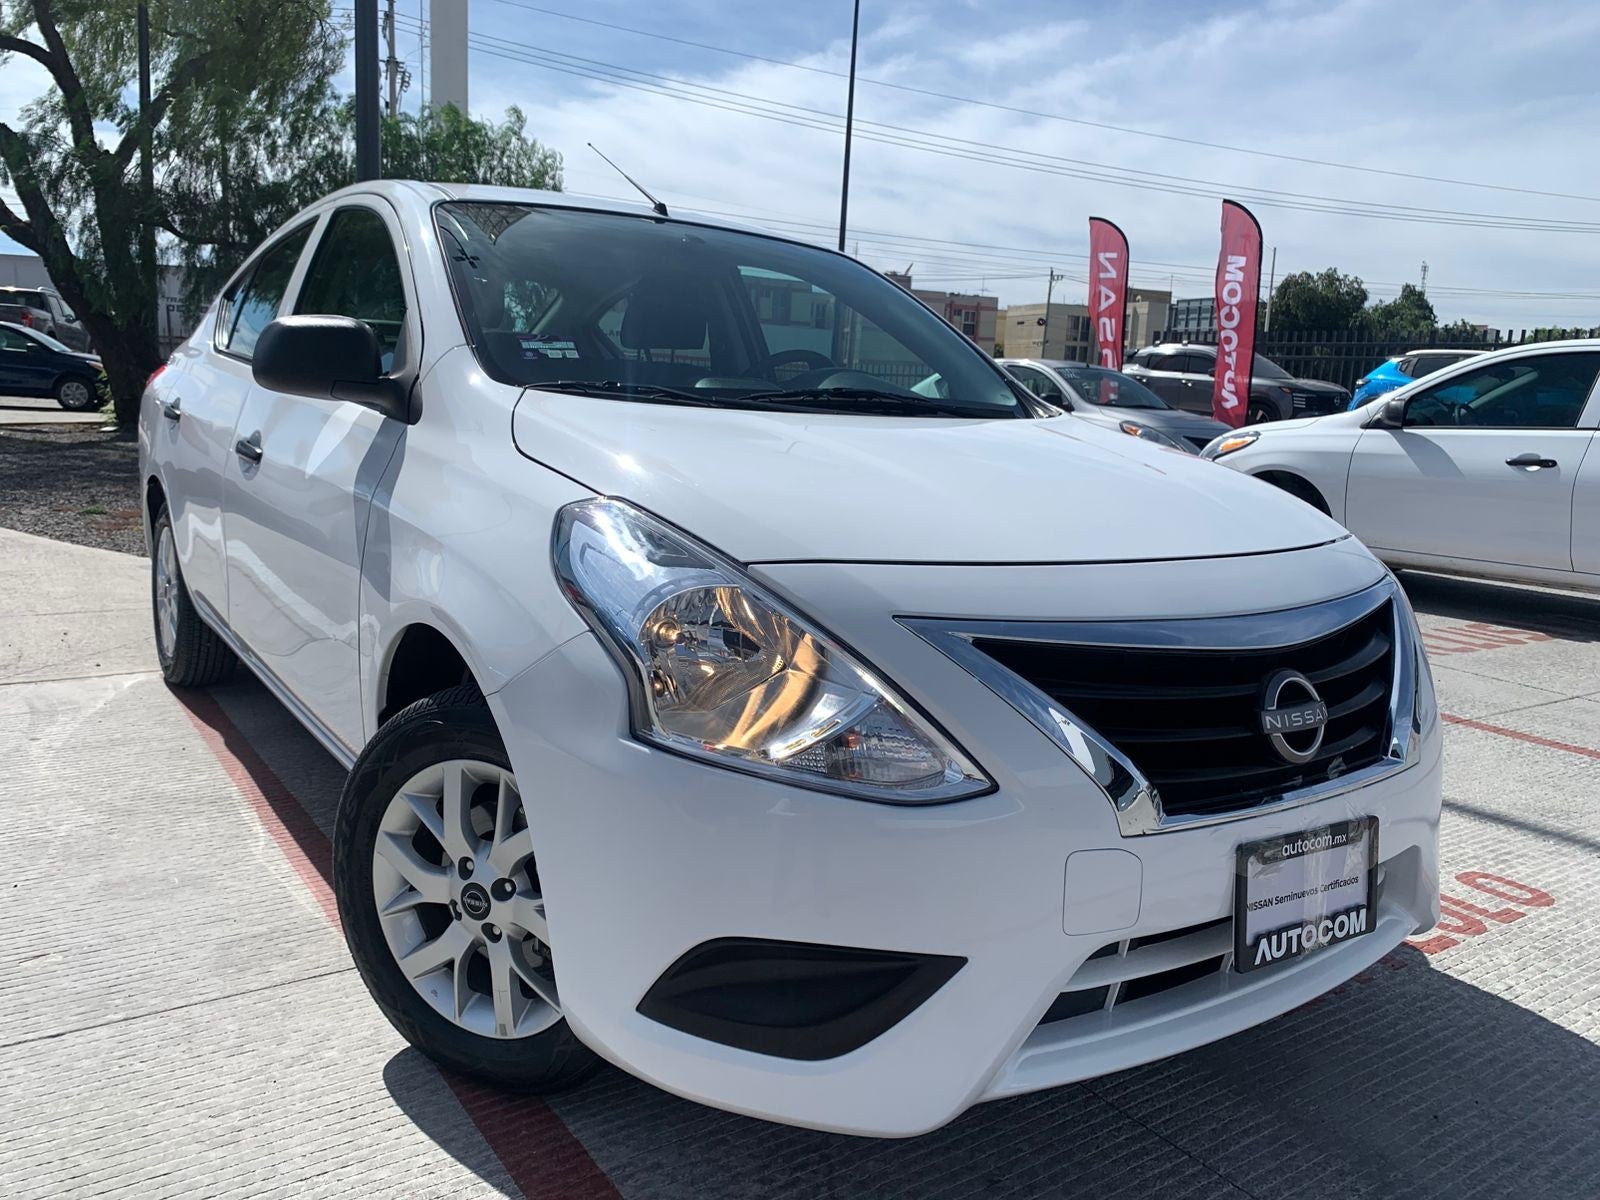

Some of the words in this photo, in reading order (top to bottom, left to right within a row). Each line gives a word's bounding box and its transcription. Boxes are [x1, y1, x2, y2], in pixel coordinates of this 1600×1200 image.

[1282, 833, 1347, 857] autocom.mx
[1274, 887, 1318, 906] Seminuevos
[1320, 875, 1359, 893] Certificados
[1254, 908, 1367, 966] AUTOCOM
